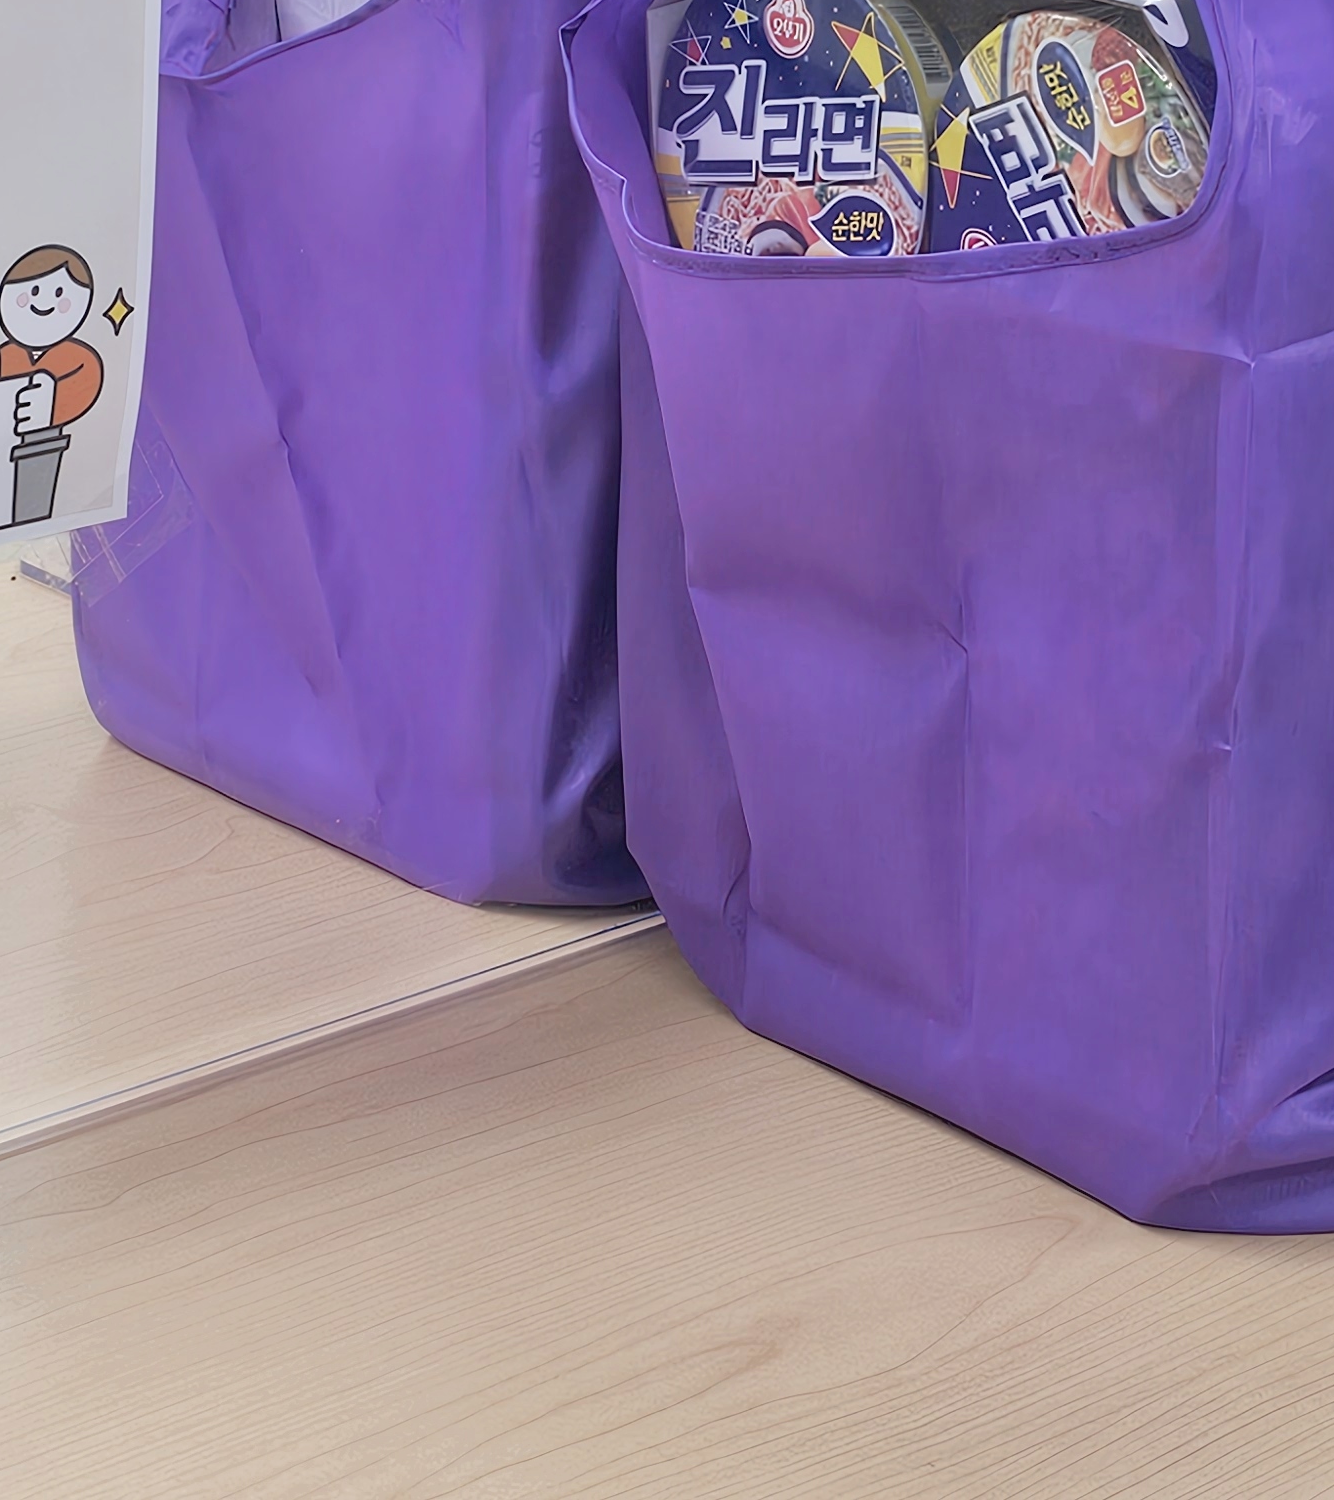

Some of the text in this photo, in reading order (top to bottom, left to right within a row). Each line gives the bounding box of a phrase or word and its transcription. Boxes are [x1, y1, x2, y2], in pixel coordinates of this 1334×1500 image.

[673, 60, 880, 182] 진라면
[1038, 60, 1092, 131] 순한맛
[831, 210, 885, 242] 순한맛
